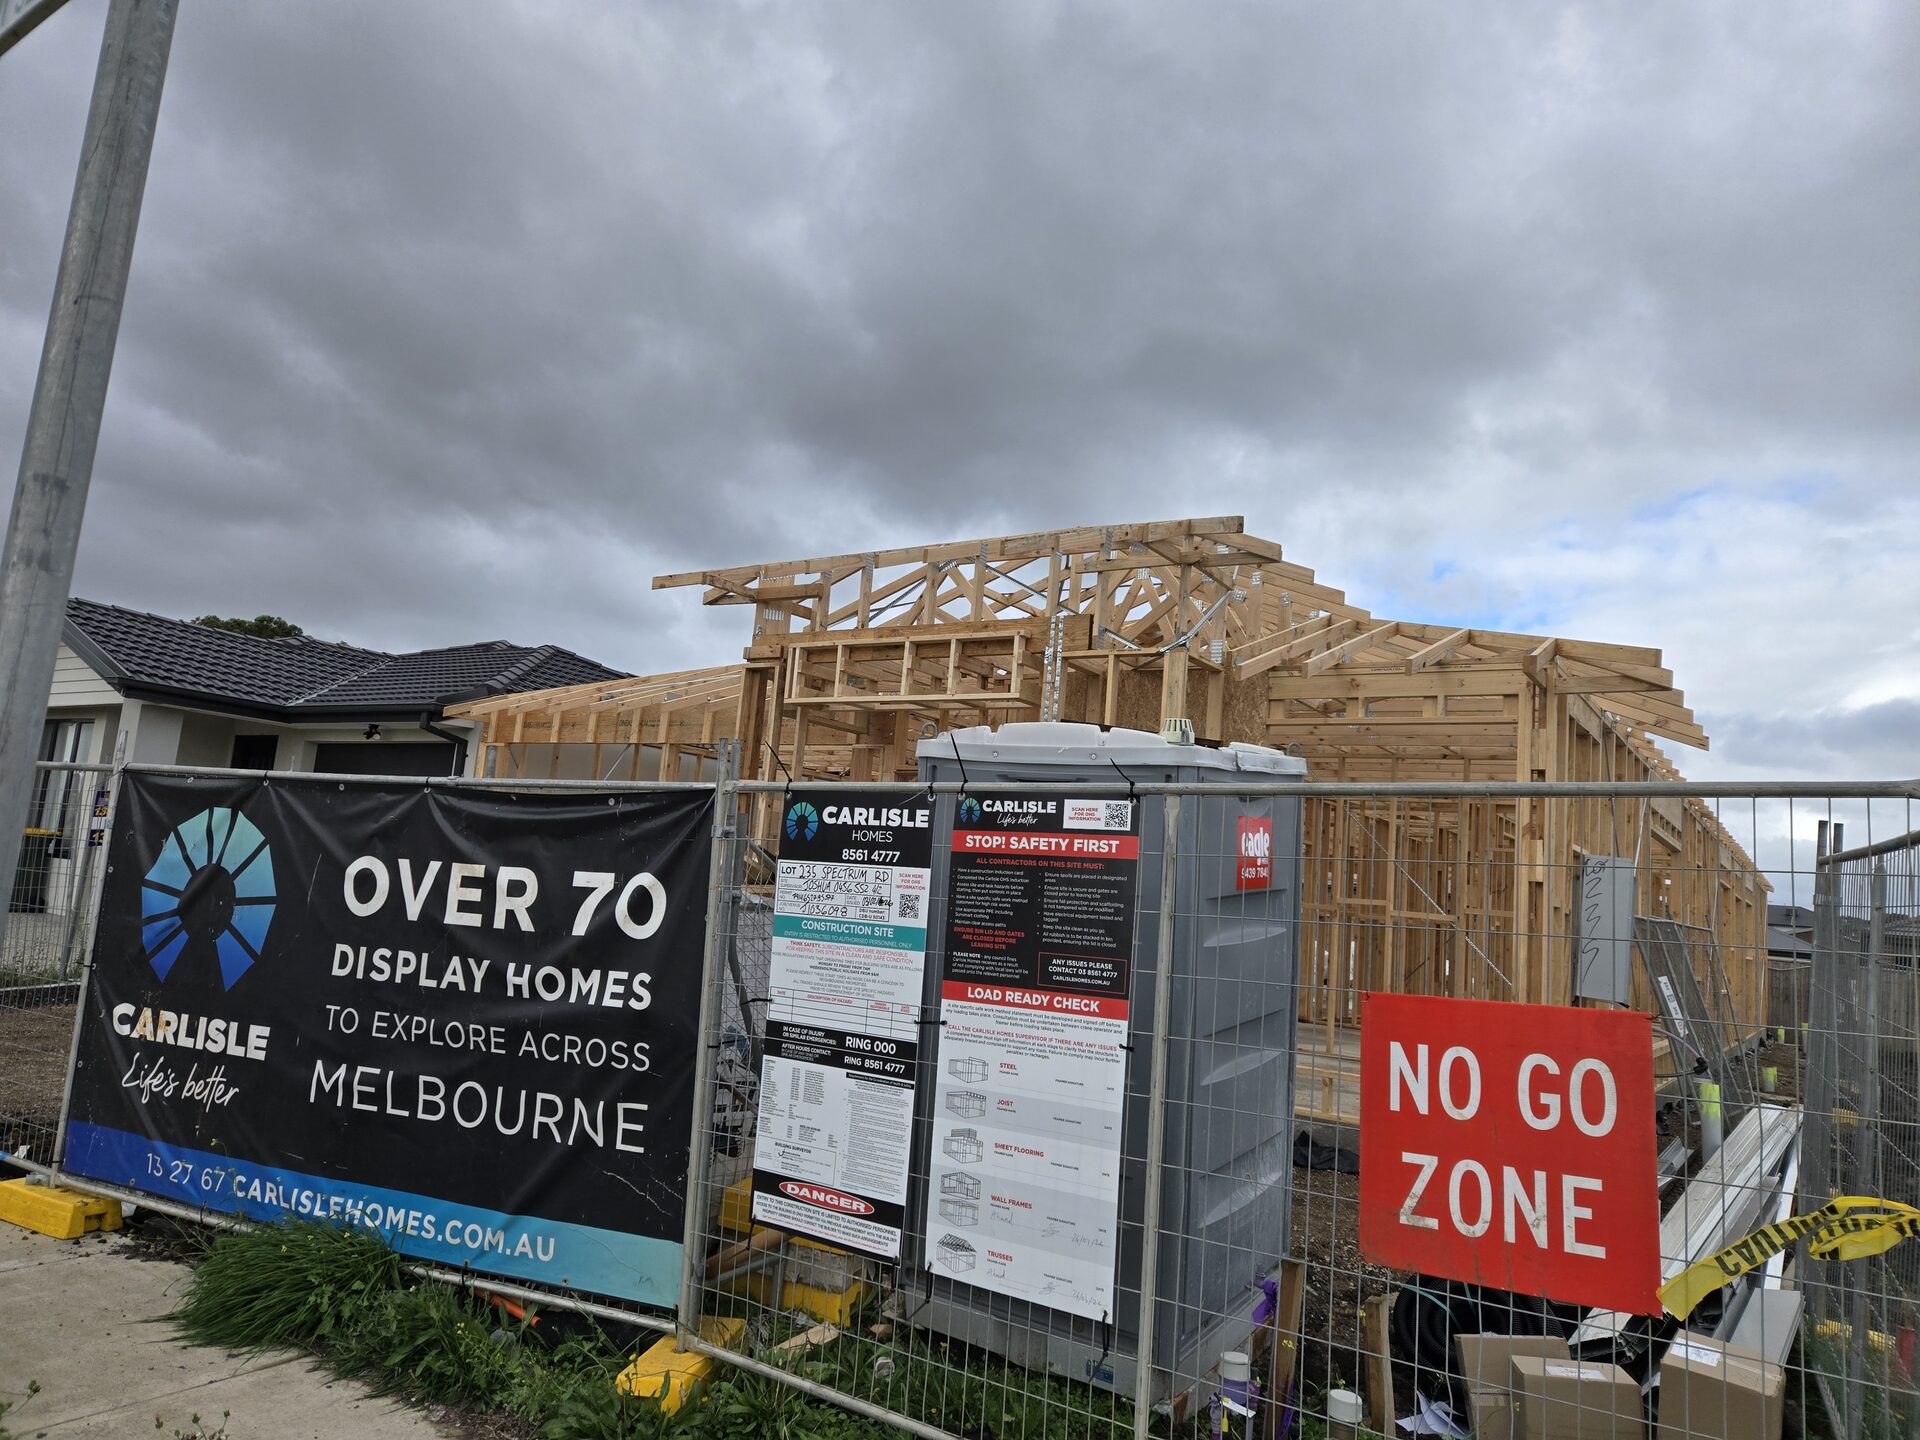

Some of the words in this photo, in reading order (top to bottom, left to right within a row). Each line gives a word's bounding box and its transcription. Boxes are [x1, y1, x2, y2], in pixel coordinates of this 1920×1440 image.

[983, 800, 1056, 813] CARLISLE
[822, 806, 929, 828] CARLISLE
[1018, 814, 1038, 826] better
[852, 830, 893, 842] HOMES
[966, 835, 1005, 848] STOP!
[1010, 836, 1069, 850] SAFETY
[1074, 839, 1120, 853] FIRST
[842, 849, 868, 861] 8561
[871, 850, 900, 862] 4777
[782, 866, 796, 875] LOT
[799, 865, 816, 879] 235
[822, 866, 867, 882] SPECTRUM
[875, 871, 889, 882] RD
[803, 879, 831, 892] JOSHUA
[344, 856, 538, 932] OVER
[571, 871, 666, 939] 70
[802, 920, 871, 935] CONSTRUCTION
[874, 927, 894, 937] SITE
[331, 944, 490, 993] DISPLAY
[507, 963, 652, 1010] HOMES
[1048, 966, 1077, 974] CONTACT
[1053, 975, 1110, 985] CARLISLEHOMES.COM.AU
[968, 987, 1002, 1001] LOAD
[1005, 991, 1050, 1006] READY
[1053, 997, 1100, 1012] CHECK
[113, 1002, 270, 1061] CARLISLE
[326, 1004, 358, 1034] TO
[372, 1011, 506, 1054] EXPLORE
[519, 1031, 650, 1071] ACROSS
[1015, 1033, 1047, 1042] SUPERVISOR
[846, 1036, 871, 1050] RING
[874, 1041, 896, 1054] 000
[844, 1056, 861, 1066] RING
[865, 1059, 883, 1070] 8561
[885, 1062, 905, 1074] 4777
[122, 1052, 179, 1103] Life's
[182, 1063, 239, 1112] better
[1390, 1041, 1481, 1120] NO
[1518, 1053, 1617, 1137] GO
[310, 1060, 648, 1153] MELBOURNE
[995, 1143, 1013, 1152] SHEET
[1014, 1147, 1044, 1157] FLOORING
[787, 1184, 865, 1212] DANGER
[991, 1195, 1007, 1204] WALL
[1008, 1199, 1032, 1210] FRAMES
[1400, 1152, 1606, 1259] ZONE
[147, 1153, 162, 1176] 13
[169, 1161, 194, 1184] 27
[201, 1168, 225, 1192] 67
[233, 1175, 554, 1262] CARLISLEHOMES.COM.AU
[988, 1250, 1013, 1262] TRUSSES
